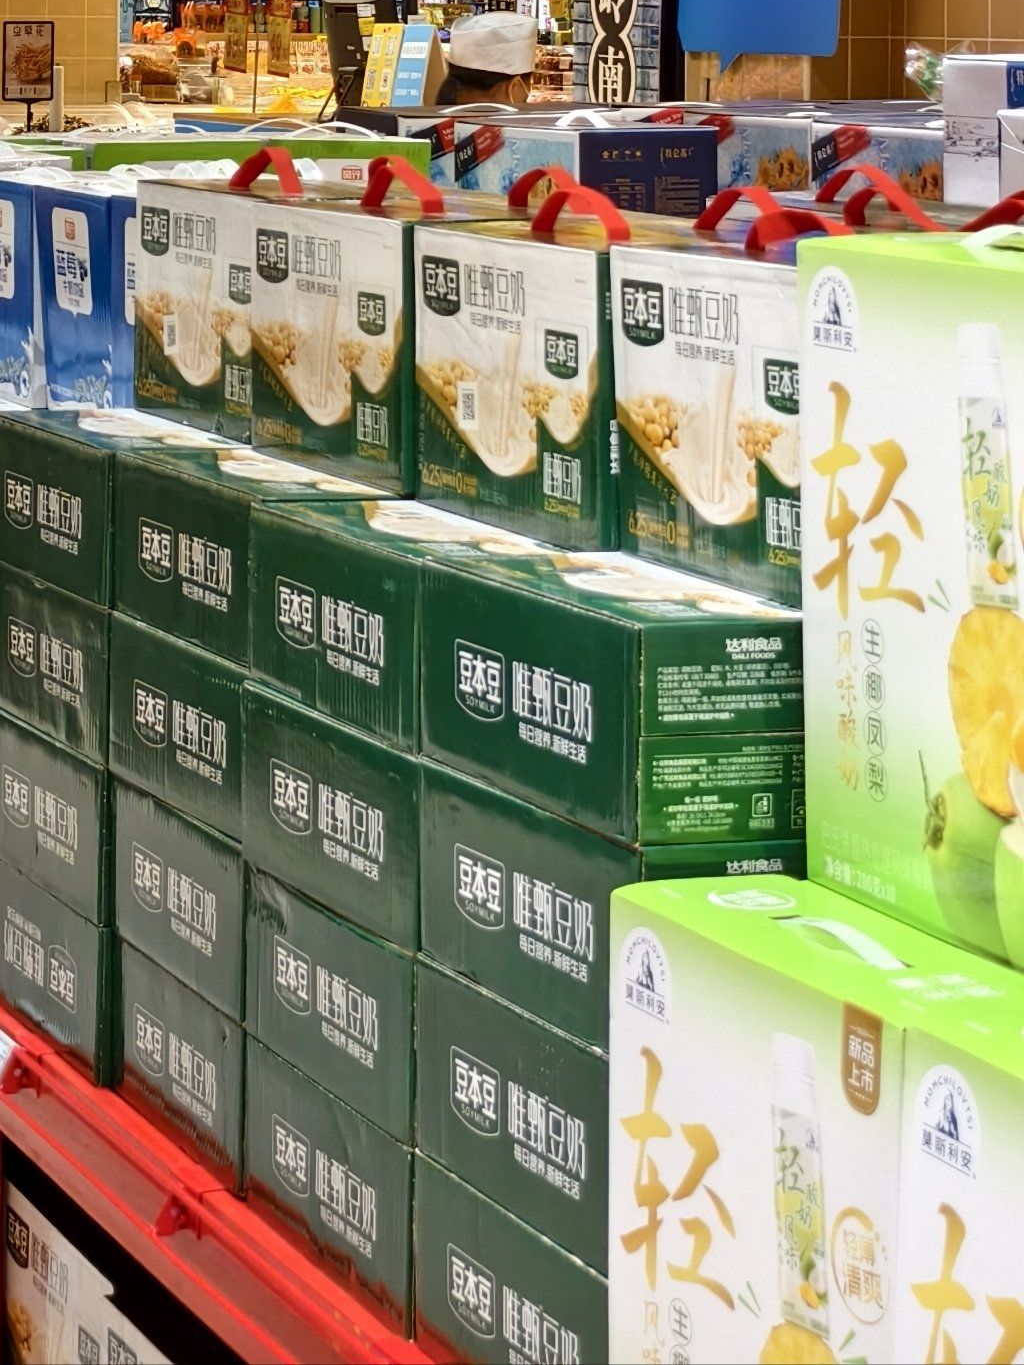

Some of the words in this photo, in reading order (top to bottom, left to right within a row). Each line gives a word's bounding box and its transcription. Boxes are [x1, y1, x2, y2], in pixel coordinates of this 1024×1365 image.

[13, 25, 44, 36] 虫草花
[143, 212, 168, 242] 豆本豆
[257, 234, 287, 269] 豆本豆
[359, 296, 384, 326] 豆本豆
[423, 263, 459, 303] 豆本豆
[464, 263, 526, 317] 唯甄豆奶
[623, 286, 662, 329] 豆本豆
[668, 287, 740, 346] 唯甄豆奶
[545, 334, 578, 368] 豆本豆
[7, 479, 31, 516] 豆本豆
[37, 484, 82, 539] 唯甄豆奶
[810, 382, 925, 621] 轻
[141, 527, 171, 568] 豆本豆
[179, 534, 232, 595] 唯甄豆奶
[10, 627, 34, 666] 豆本豆
[279, 585, 313, 633] 豆本豆
[321, 596, 384, 667] 唯甄豆奶
[726, 637, 783, 652] 达利食品
[459, 650, 501, 704] 豆本豆
[512, 661, 593, 743] 唯甄豆奶
[136, 690, 166, 732] 豆本豆
[172, 700, 226, 769] 唯甄豆奶
[4, 773, 29, 816] 豆本豆
[274, 769, 309, 820] 豆本豆
[318, 783, 384, 863] 唯甄豆奶
[133, 851, 161, 899] 豆本豆
[726, 858, 783, 874] 达利食品
[459, 856, 501, 914] 豆本豆
[513, 872, 594, 962] 唯甄豆奶
[275, 949, 309, 1001] 豆本豆
[316, 965, 379, 1051] 唯甄豆奶
[136, 1012, 163, 1061] 豆本豆
[848, 1034, 875, 1067] 新品
[848, 1065, 874, 1093] 上市
[455, 1058, 496, 1117] 豆本豆
[508, 1081, 586, 1181] 唯甄豆奶
[921, 1131, 972, 1171] 莫斯利安
[275, 1127, 307, 1182] 豆本豆
[315, 1150, 376, 1241] 唯甄豆奶
[620, 1046, 735, 1312] 轻
[452, 1256, 492, 1317] 豆本豆
